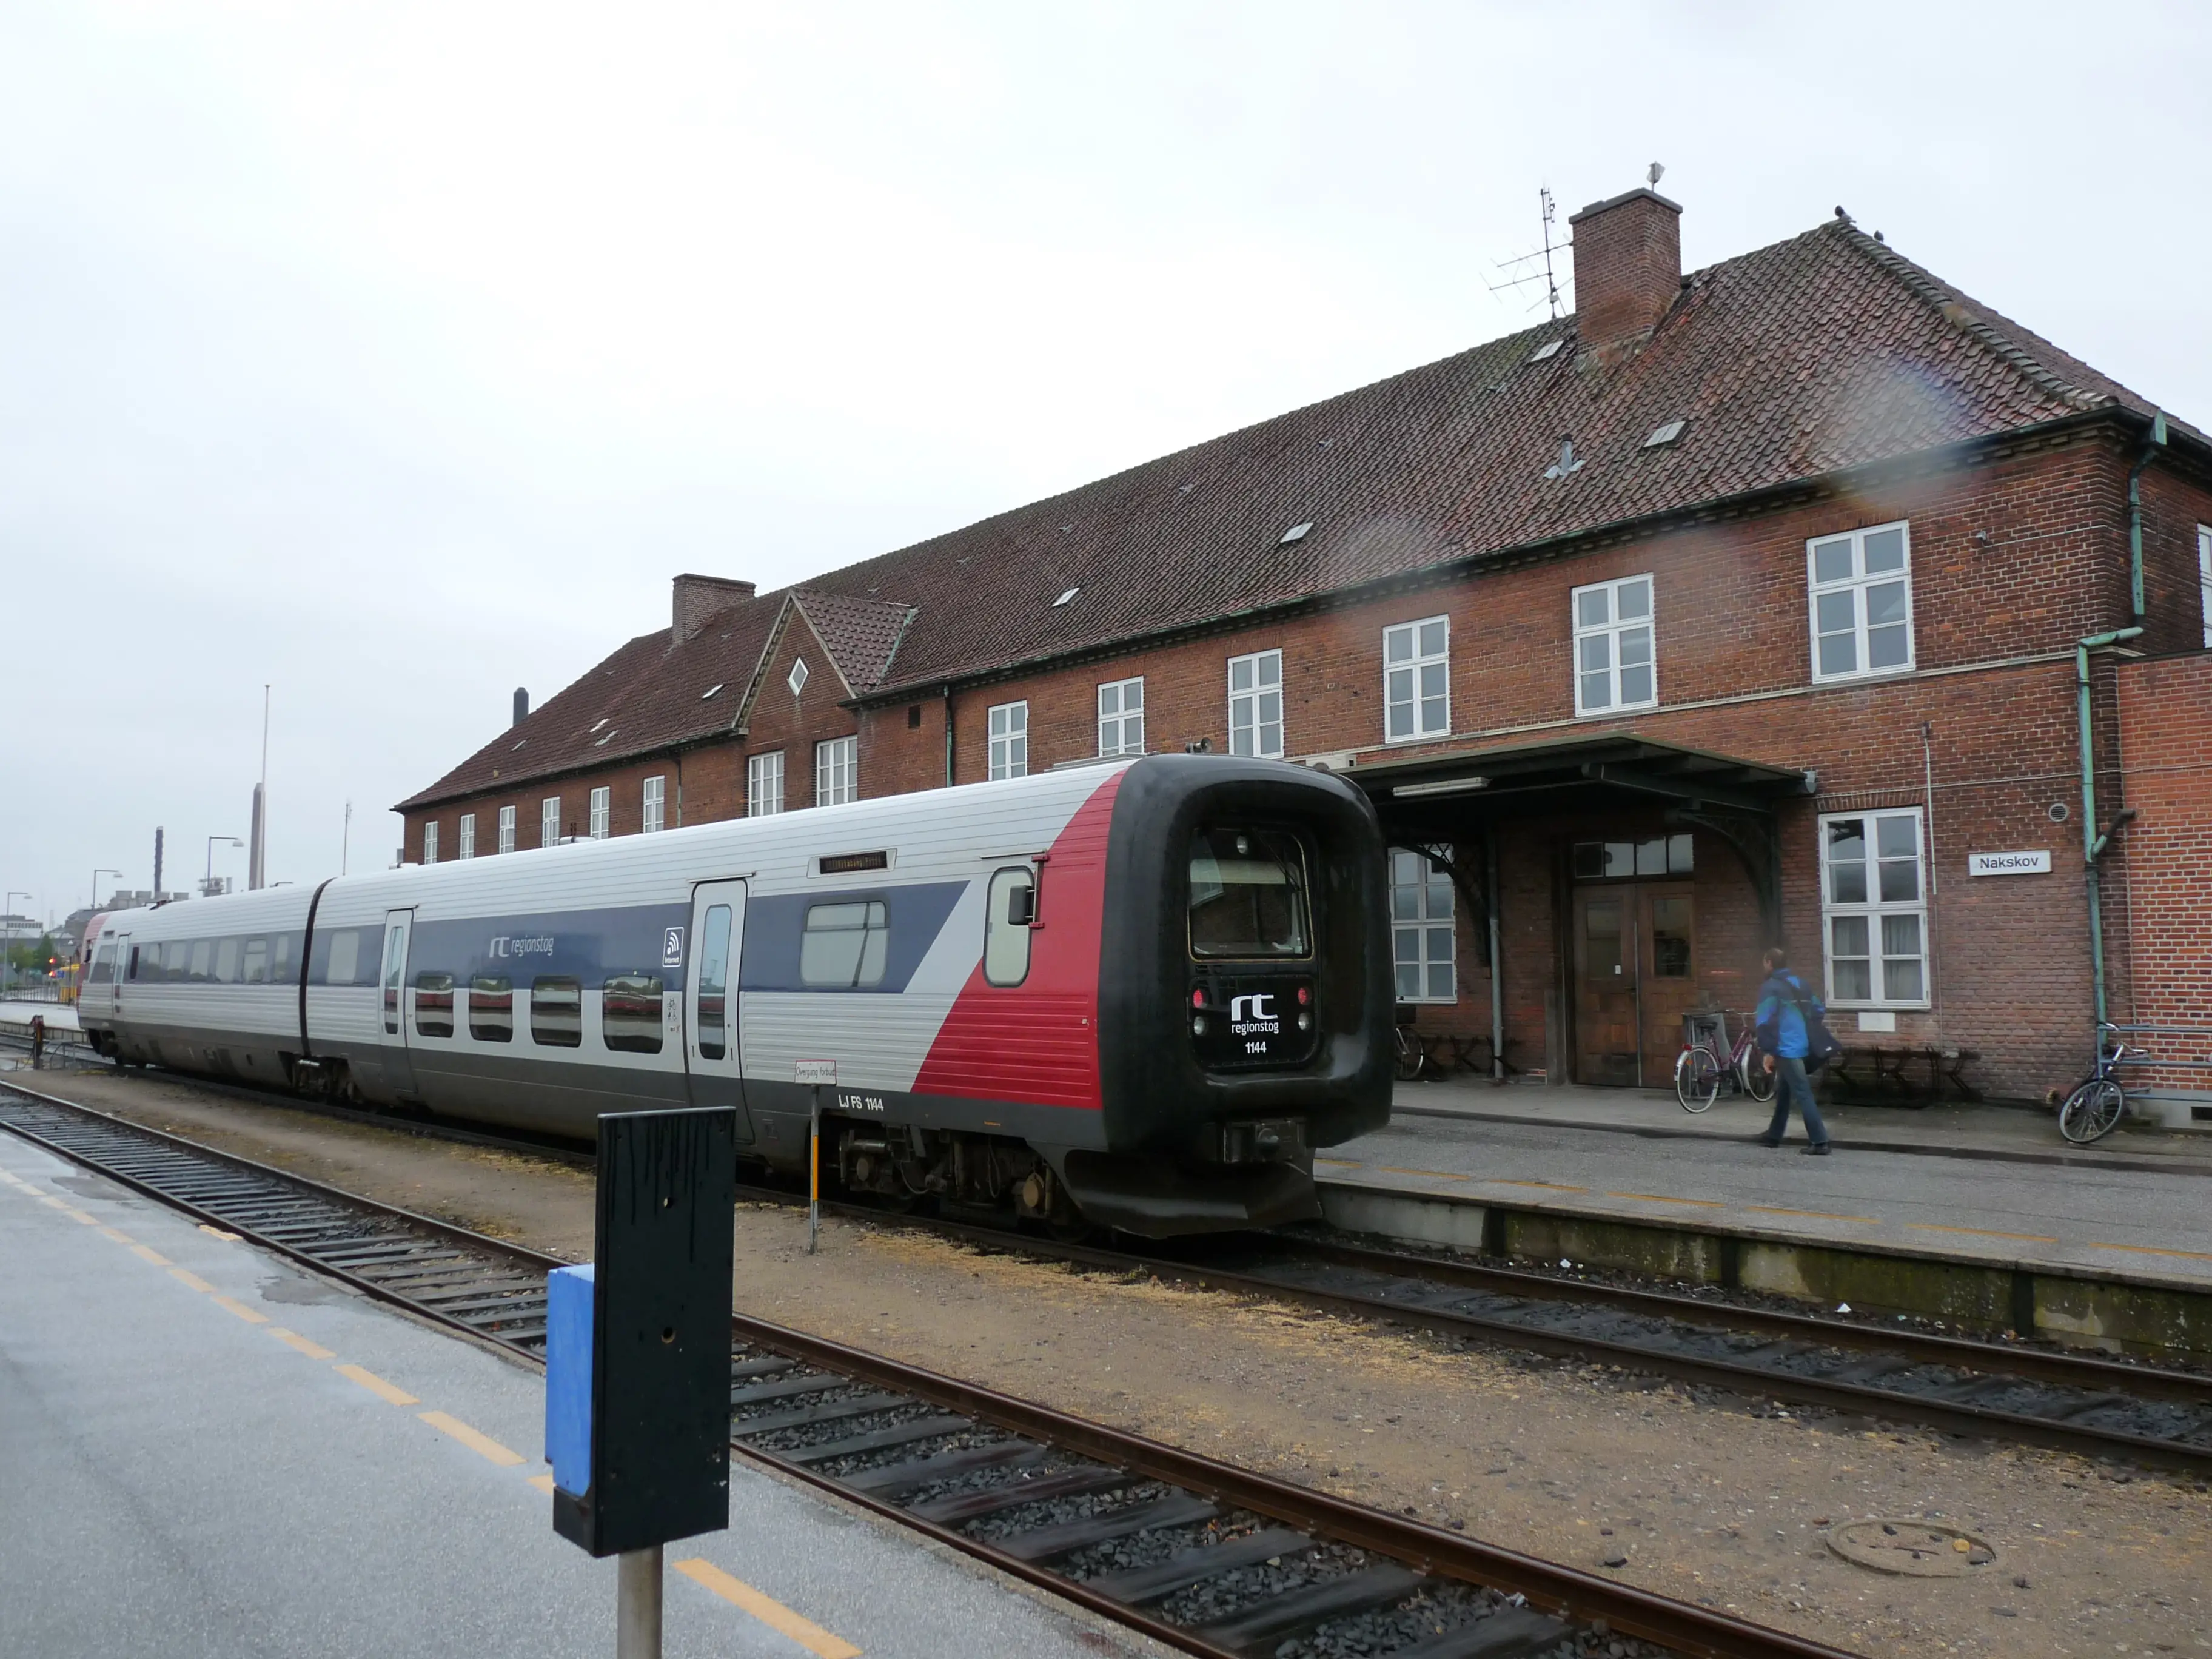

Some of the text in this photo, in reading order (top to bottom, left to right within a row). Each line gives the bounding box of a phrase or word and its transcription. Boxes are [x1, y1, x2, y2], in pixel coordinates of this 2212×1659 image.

[1980, 856, 2039, 868] Nakskov
[511, 934, 554, 957] regionstog
[1232, 1020, 1279, 1036] regionstog
[1245, 1041, 1267, 1054] 1144
[796, 1067, 818, 1079] Overgang
[850, 1095, 862, 1109] FS
[865, 1096, 884, 1111] 1144
